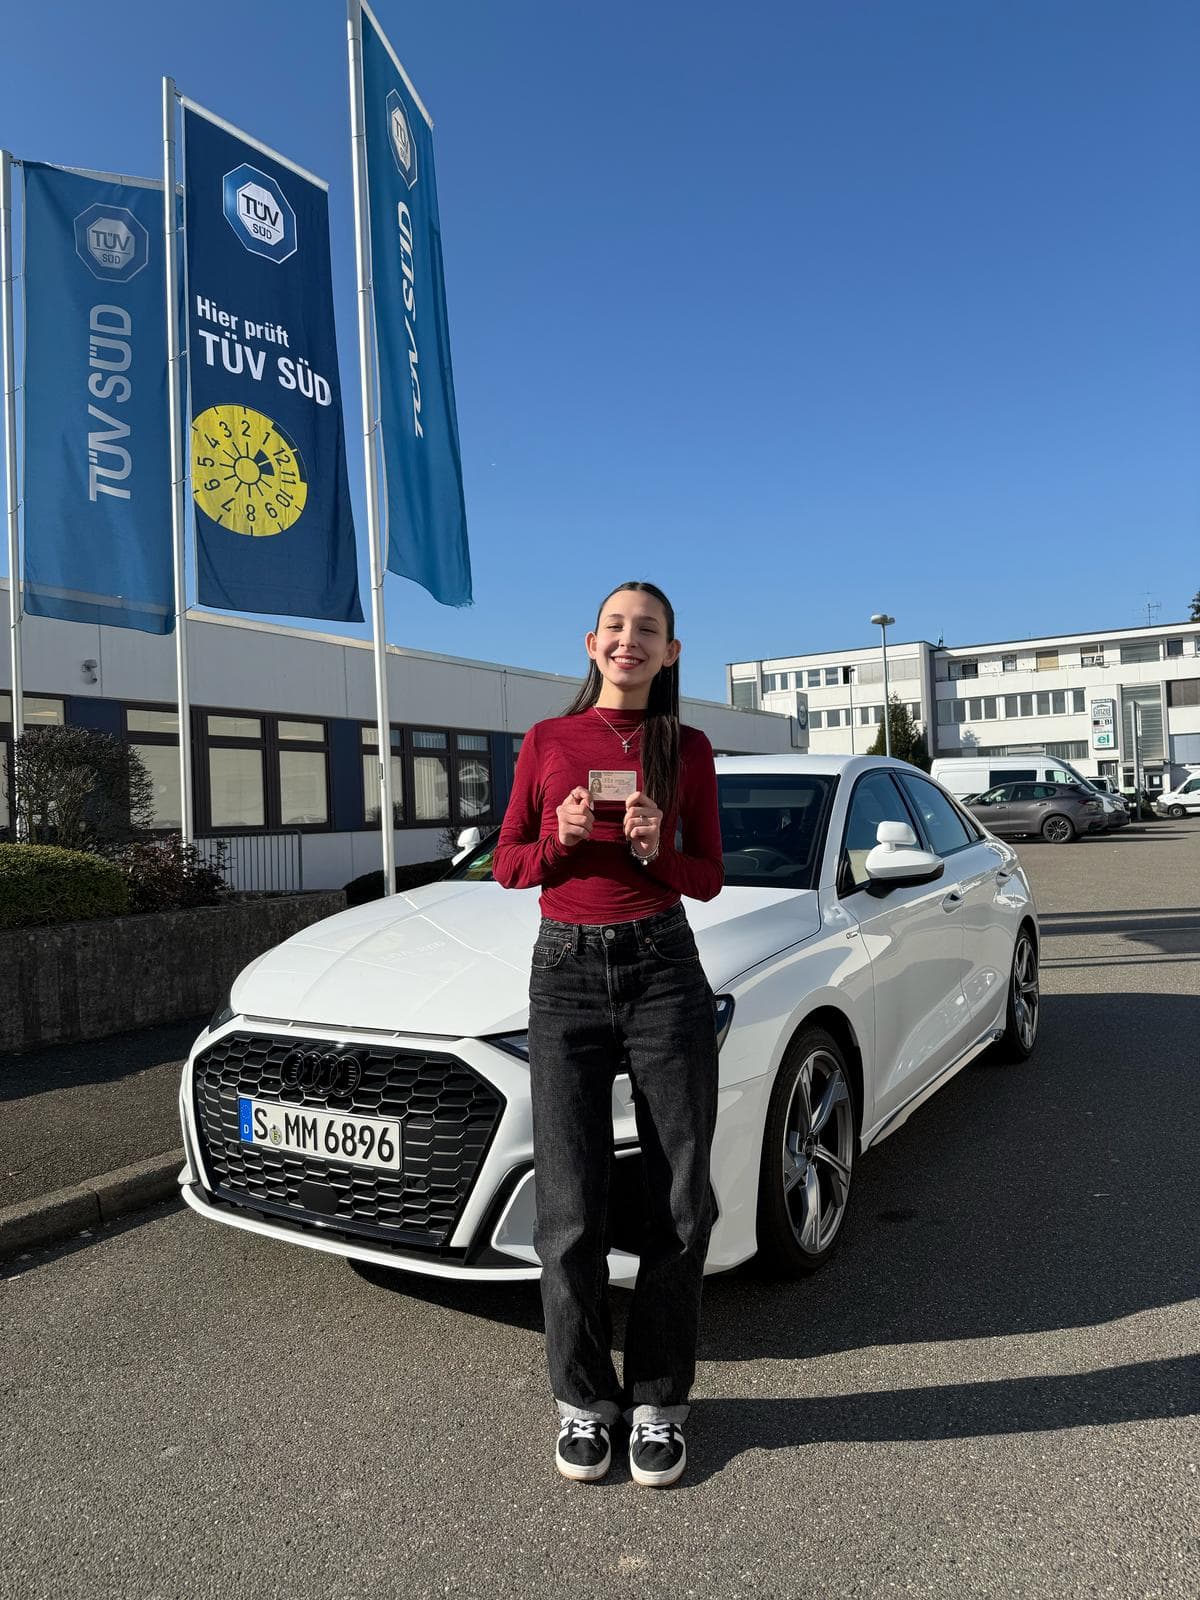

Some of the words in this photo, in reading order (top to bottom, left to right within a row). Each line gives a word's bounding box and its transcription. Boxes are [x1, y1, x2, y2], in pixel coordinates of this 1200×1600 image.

[241, 193, 279, 227] TÜV
[91, 229, 132, 251] TÜV
[252, 223, 272, 240] SÜD
[102, 253, 121, 265] SÜD
[196, 294, 239, 330] Hier
[244, 319, 290, 348] prüft
[87, 304, 132, 403] SÜD
[198, 328, 267, 381] TÜV
[277, 356, 332, 407] SÜD
[218, 421, 233, 438] 3
[241, 420, 251, 437] 2
[204, 433, 220, 449] 4
[262, 431, 271, 445] 1
[87, 403, 132, 502] TÜV
[273, 447, 291, 466] 12
[197, 456, 215, 468] 5
[280, 471, 297, 485] 11
[220, 497, 236, 513] 7
[275, 488, 294, 508] 10
[245, 504, 256, 522] 8
[254, 1107, 268, 1140] S
[284, 1112, 318, 1151] MM
[324, 1120, 395, 1163] 6896
